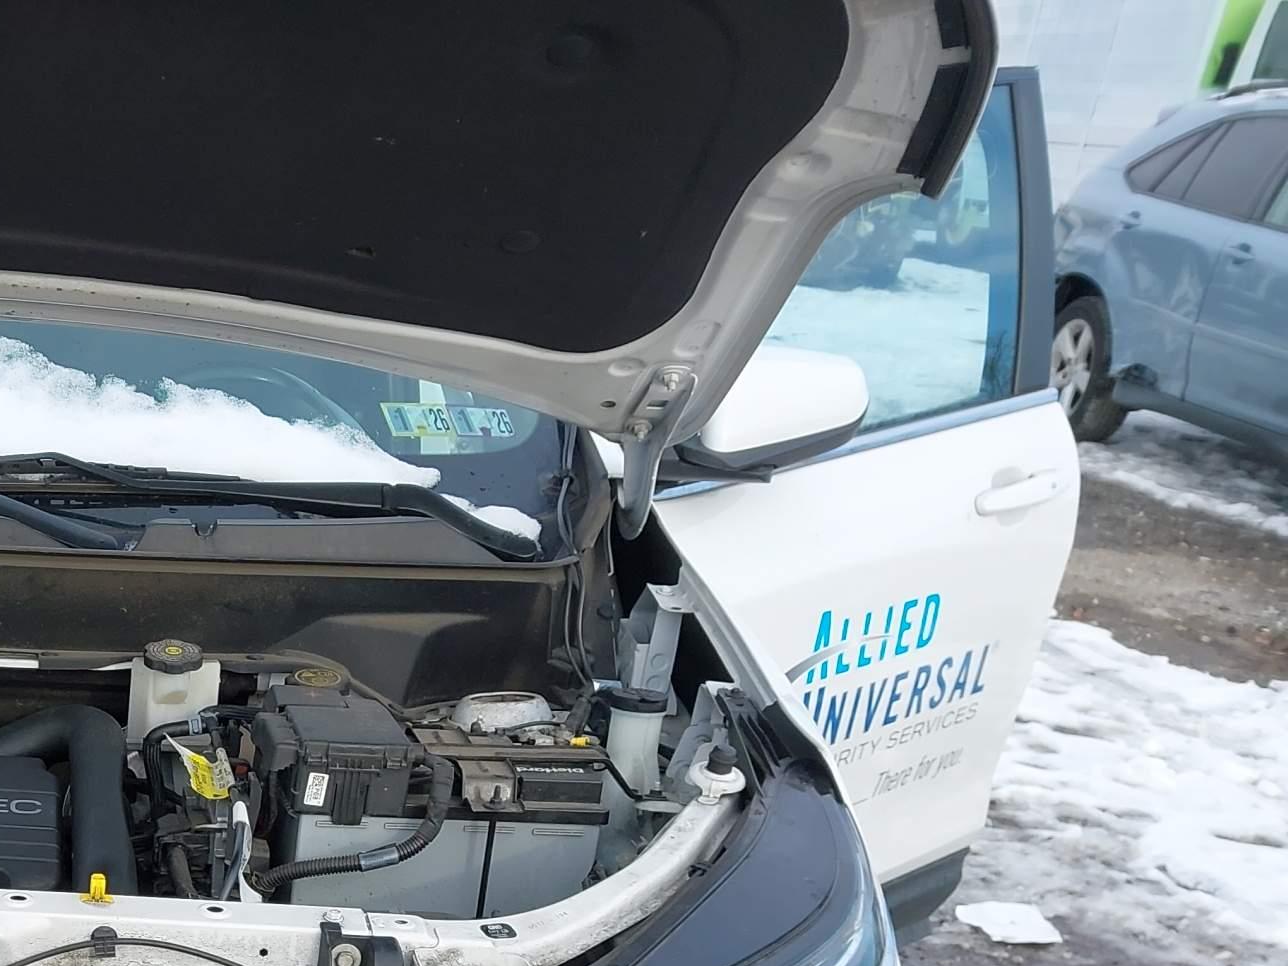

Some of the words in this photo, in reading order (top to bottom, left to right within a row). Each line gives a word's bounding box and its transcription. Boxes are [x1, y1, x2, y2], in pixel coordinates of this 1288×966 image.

[429, 408, 450, 431] 26
[492, 411, 513, 434] 26
[806, 593, 941, 685] ALLIED
[803, 643, 992, 746] UNIVERSAL
[834, 737, 883, 768] RITY
[885, 702, 979, 749] SERVICES
